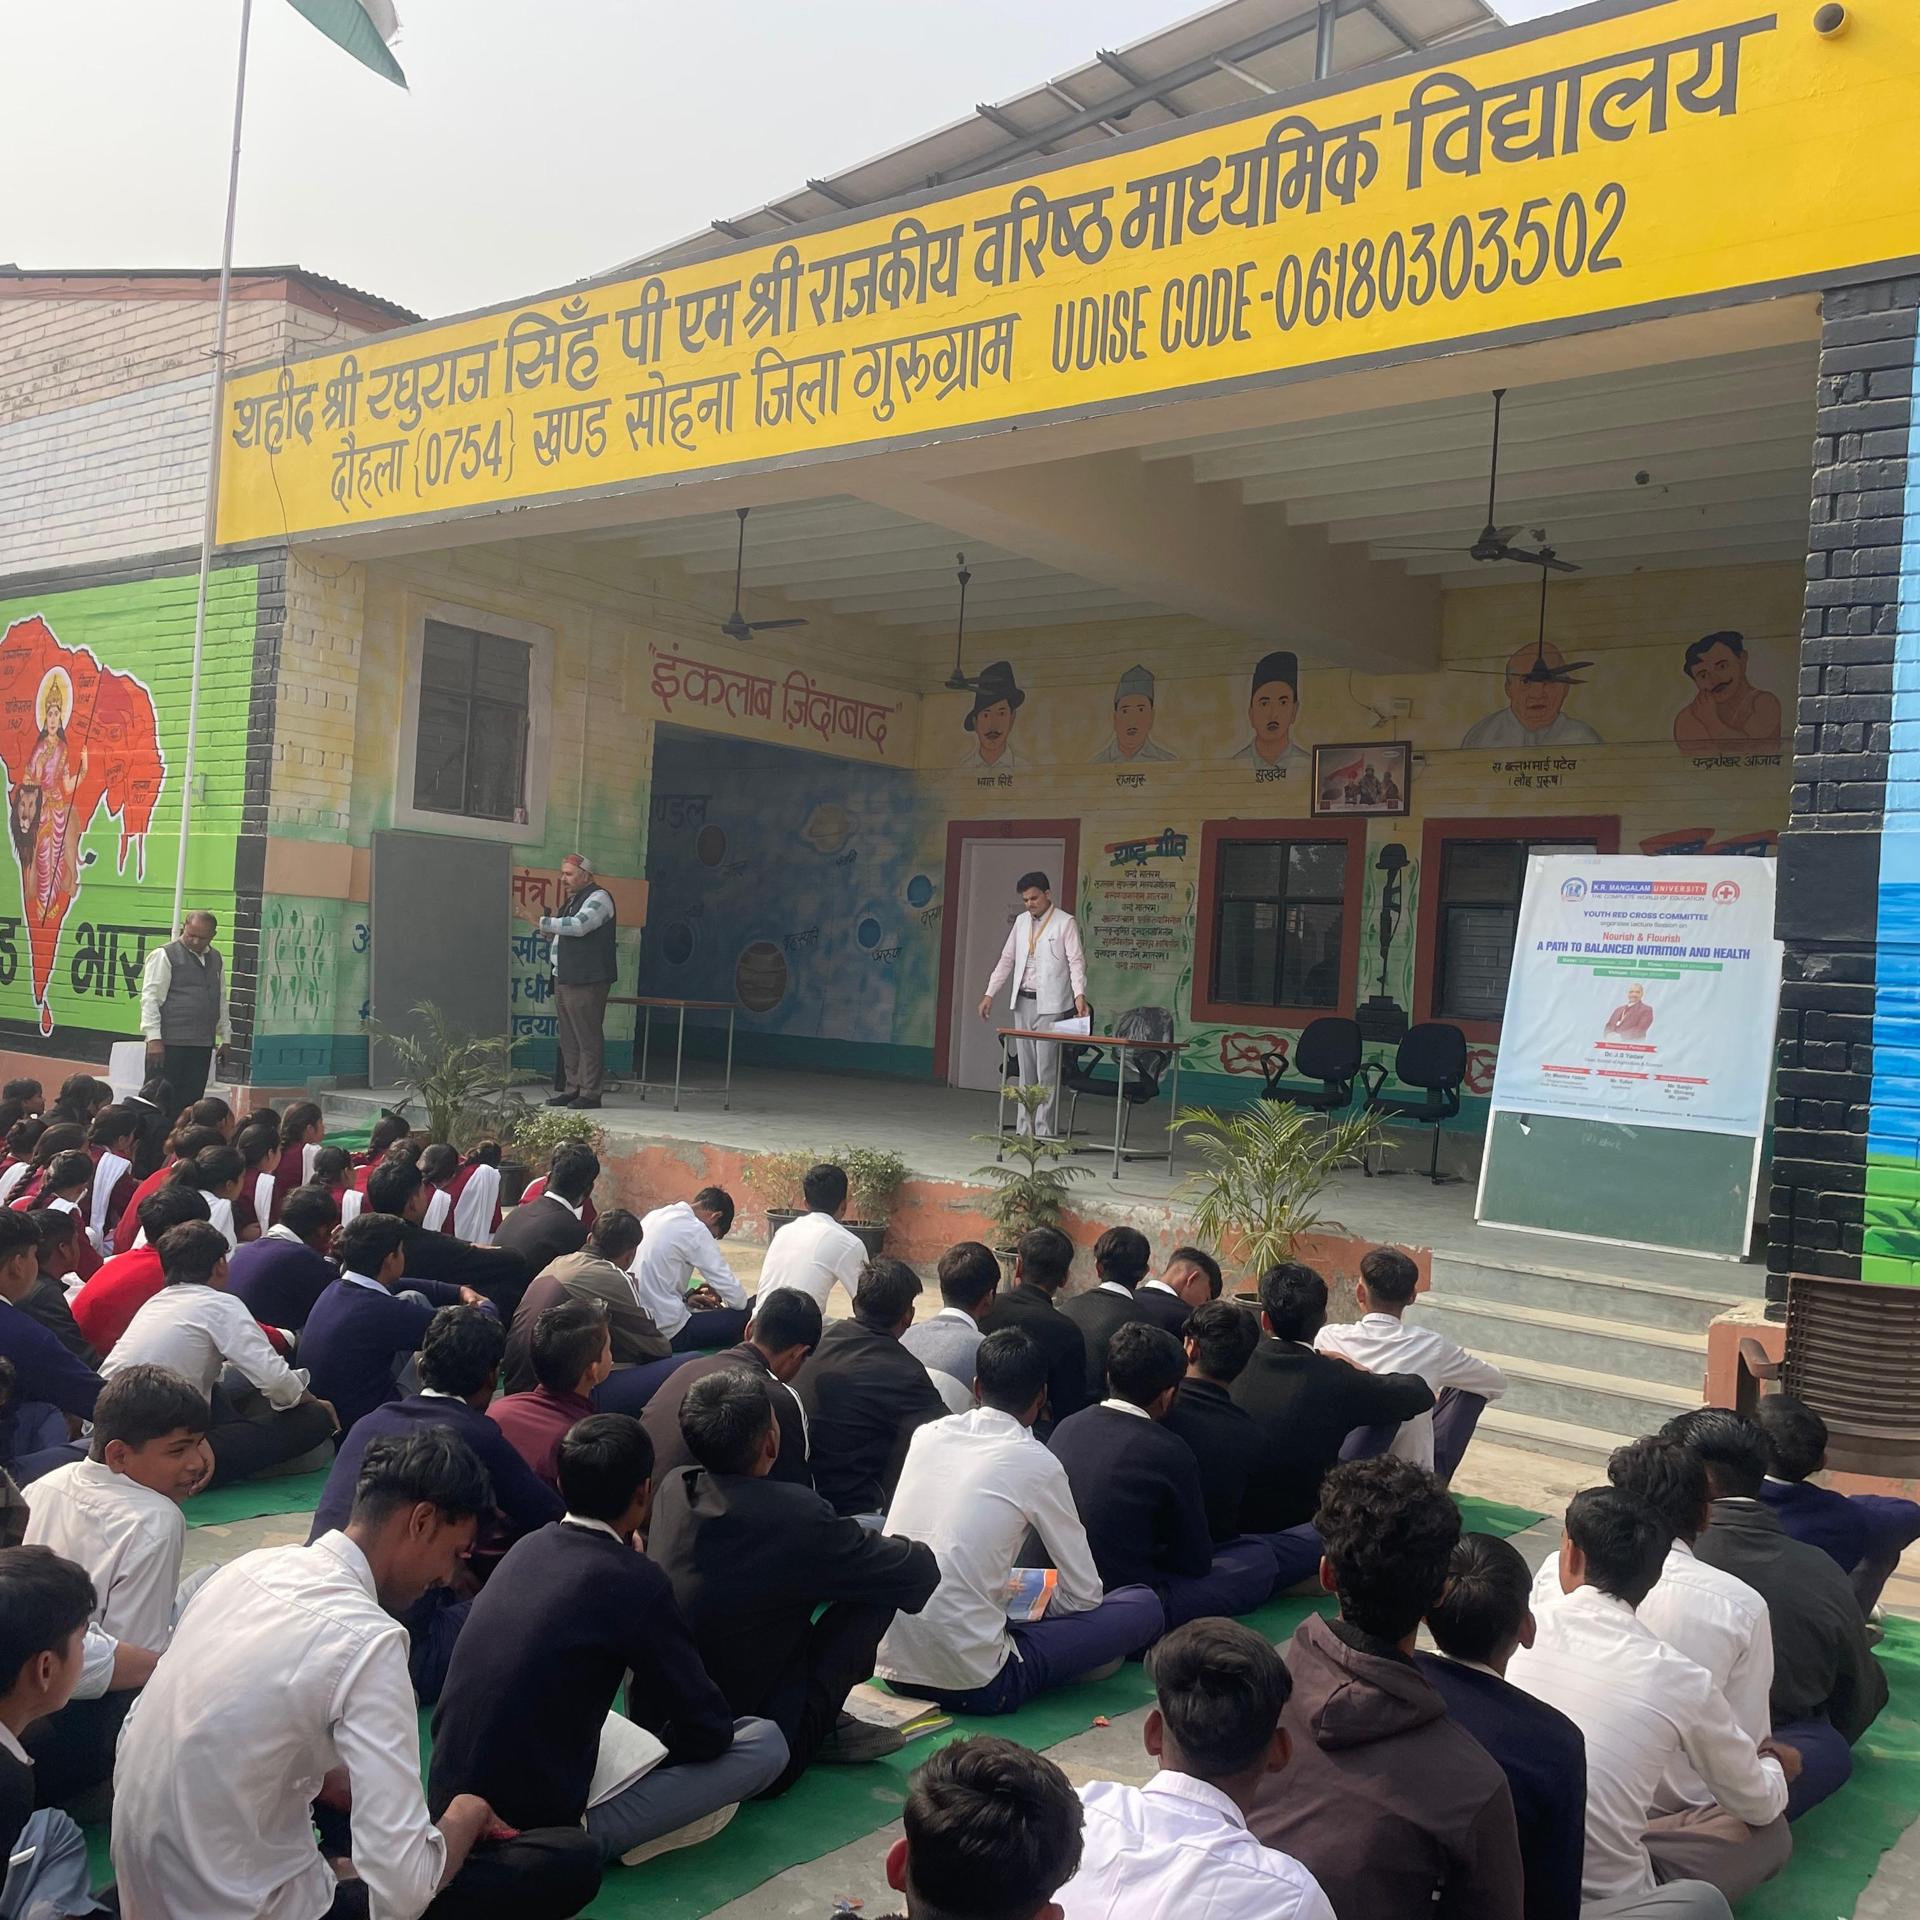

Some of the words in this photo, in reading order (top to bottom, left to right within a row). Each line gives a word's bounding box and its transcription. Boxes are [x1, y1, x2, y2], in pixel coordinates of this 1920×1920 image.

[233, 367, 318, 454] शहीद
[322, 354, 363, 432] श्री
[367, 339, 498, 431] रघुराज
[616, 277, 671, 366] पी
[675, 280, 741, 353] एम
[742, 245, 804, 339] श्री
[808, 217, 965, 326] राजकीय
[973, 185, 1114, 287] वरिष्ठ
[1121, 115, 1381, 251] माध्यमिक
[1393, 13, 1777, 190] विद्यालय
[1052, 285, 1152, 373] UDISE
[330, 431, 409, 513] दौहला
[533, 399, 611, 466] खण्ड
[625, 370, 741, 451] सोहना
[751, 346, 845, 427] जिला
[1609, 884, 1651, 892] MANGALAM
[1653, 885, 1706, 893] UNIVERSITY
[1584, 910, 1611, 918] YOUTH
[1659, 913, 1709, 921] COMMITTEE
[1602, 931, 1635, 942] Nourish
[1637, 933, 1644, 942] &
[1647, 932, 1681, 944] Flourish
[1537, 941, 1545, 950] A
[1546, 941, 1569, 952] PATH
[1571, 942, 1582, 952] TO
[1584, 943, 1634, 955] BALANCED
[1636, 945, 1688, 957] NUTRITION
[1689, 947, 1711, 958] AND
[1713, 948, 1750, 960] HEALTH
